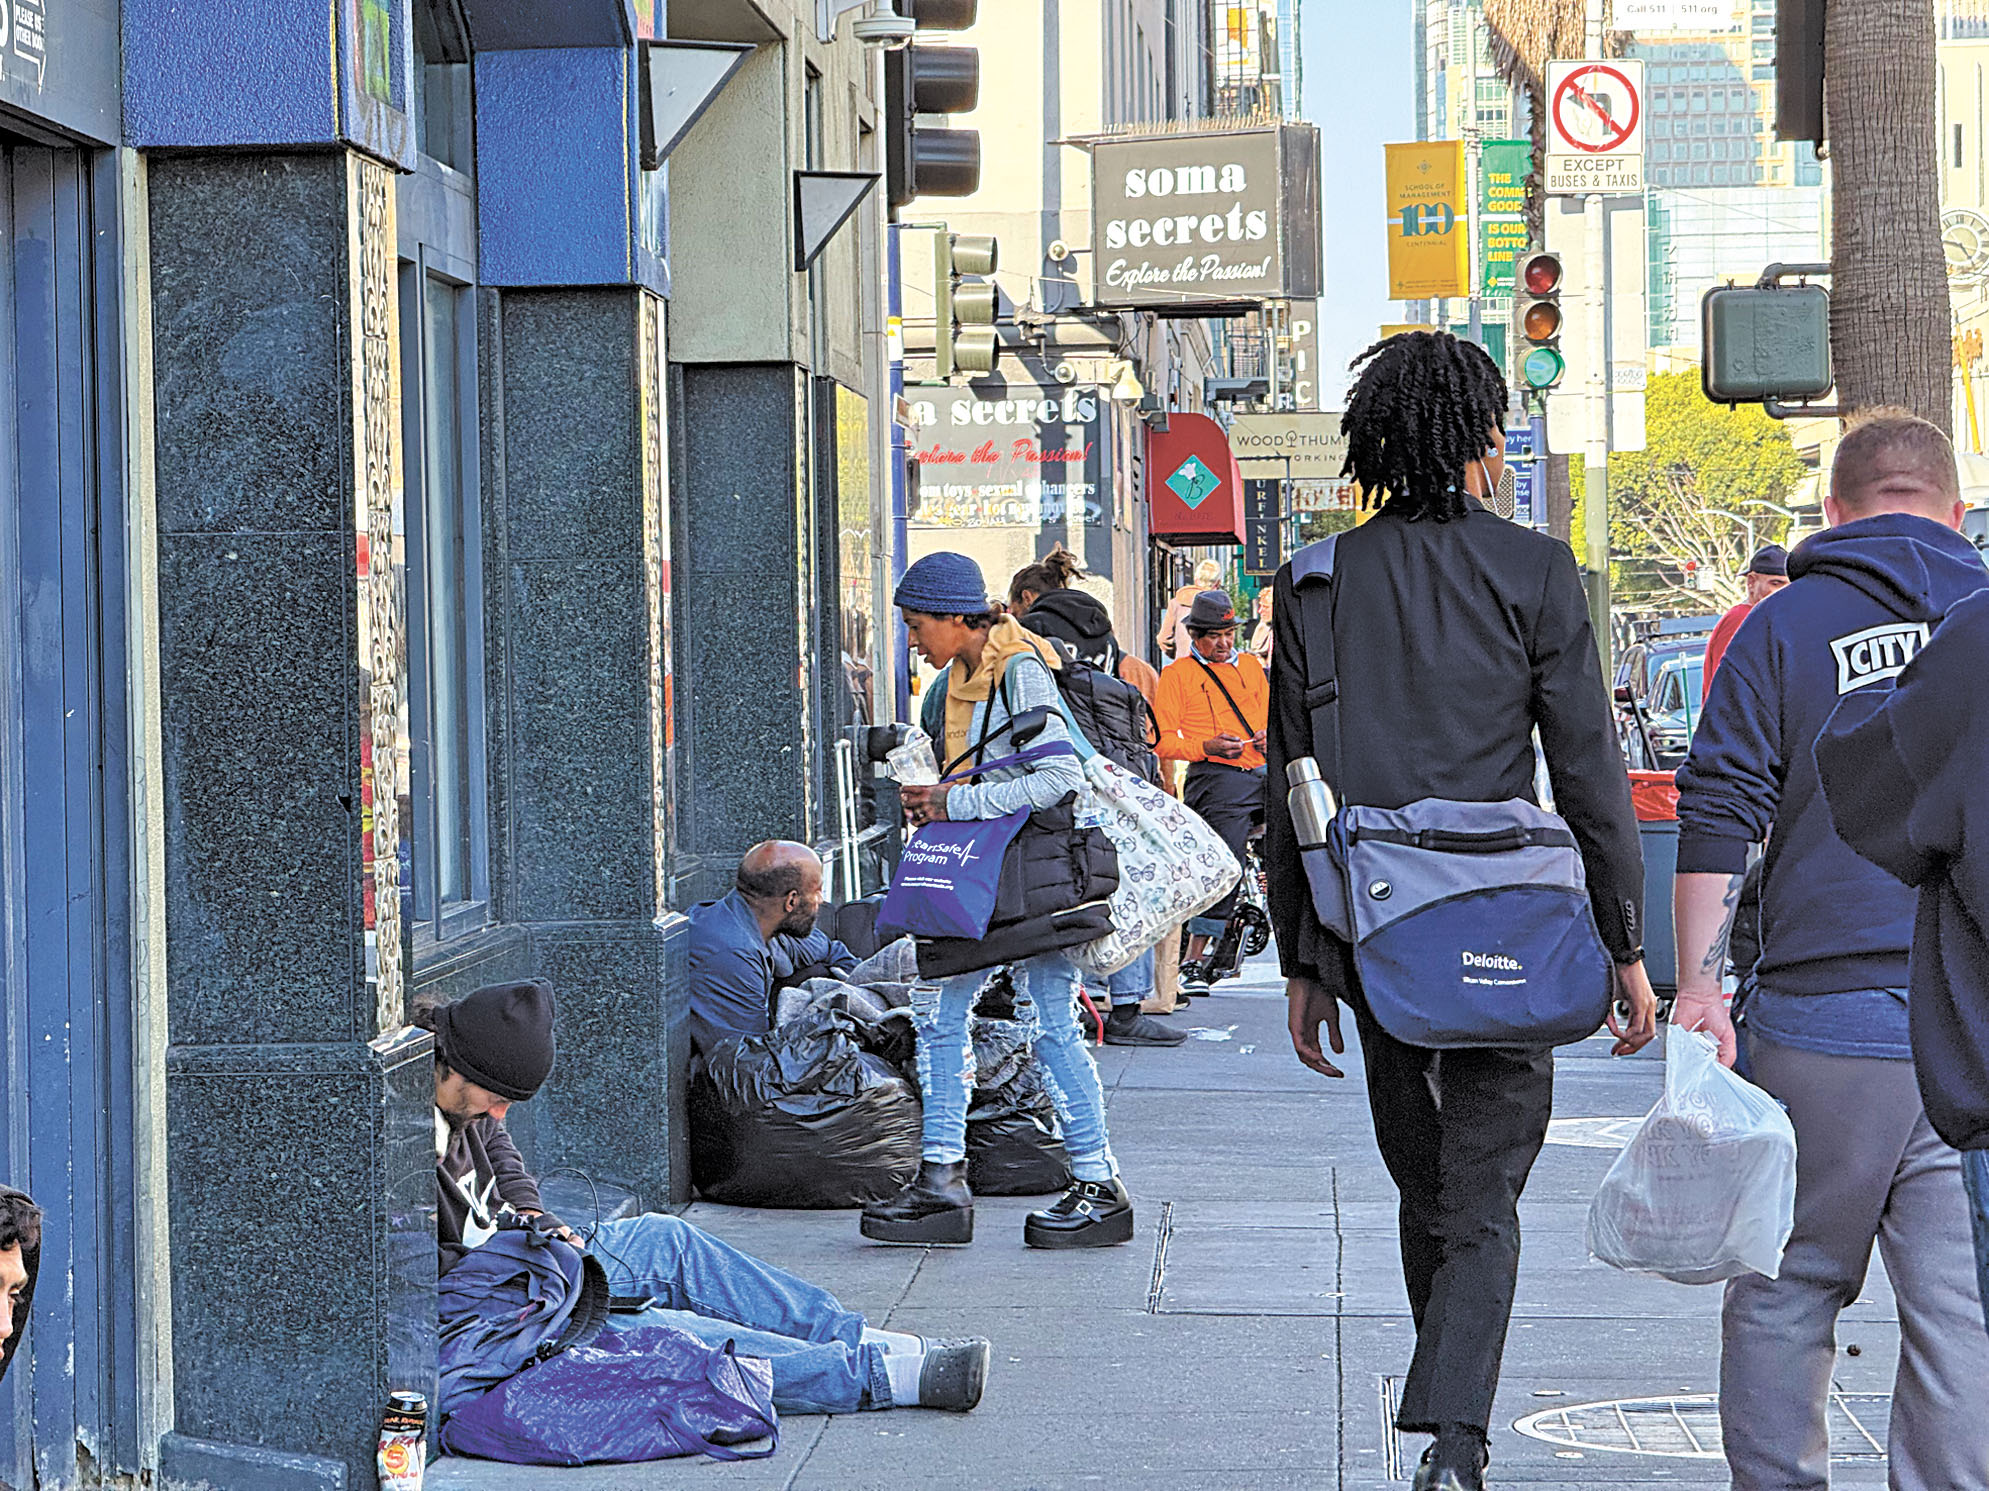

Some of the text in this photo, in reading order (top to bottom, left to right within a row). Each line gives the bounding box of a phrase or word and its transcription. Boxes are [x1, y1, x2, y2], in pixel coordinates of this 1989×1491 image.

[15, 4, 34, 29] PLEASE
[1649, 4, 1665, 13] 511
[1562, 158, 1625, 172] EXCEPT
[1125, 163, 1247, 198] soma
[1488, 173, 1512, 184] THE
[1551, 173, 1638, 188] BUSES & TAXIS
[1400, 191, 1451, 199] MANAGEMENT
[1488, 187, 1533, 198] COMM
[1106, 201, 1267, 249] secrets
[1398, 202, 1455, 237] 100
[1488, 223, 1527, 235] IS OUR
[1488, 237, 1528, 248] BOTTO
[1488, 251, 1513, 262] LINE
[1106, 254, 1272, 292] Explore the Passion!
[950, 390, 1097, 425] secrets
[1236, 435, 1284, 447] WOOD
[970, 439, 1001, 465] the
[1011, 438, 1093, 465] Passion!
[978, 479, 1023, 498] sexual
[1851, 632, 1917, 676] CITY
[911, 839, 962, 857] eartSafe
[903, 850, 949, 866] Program
